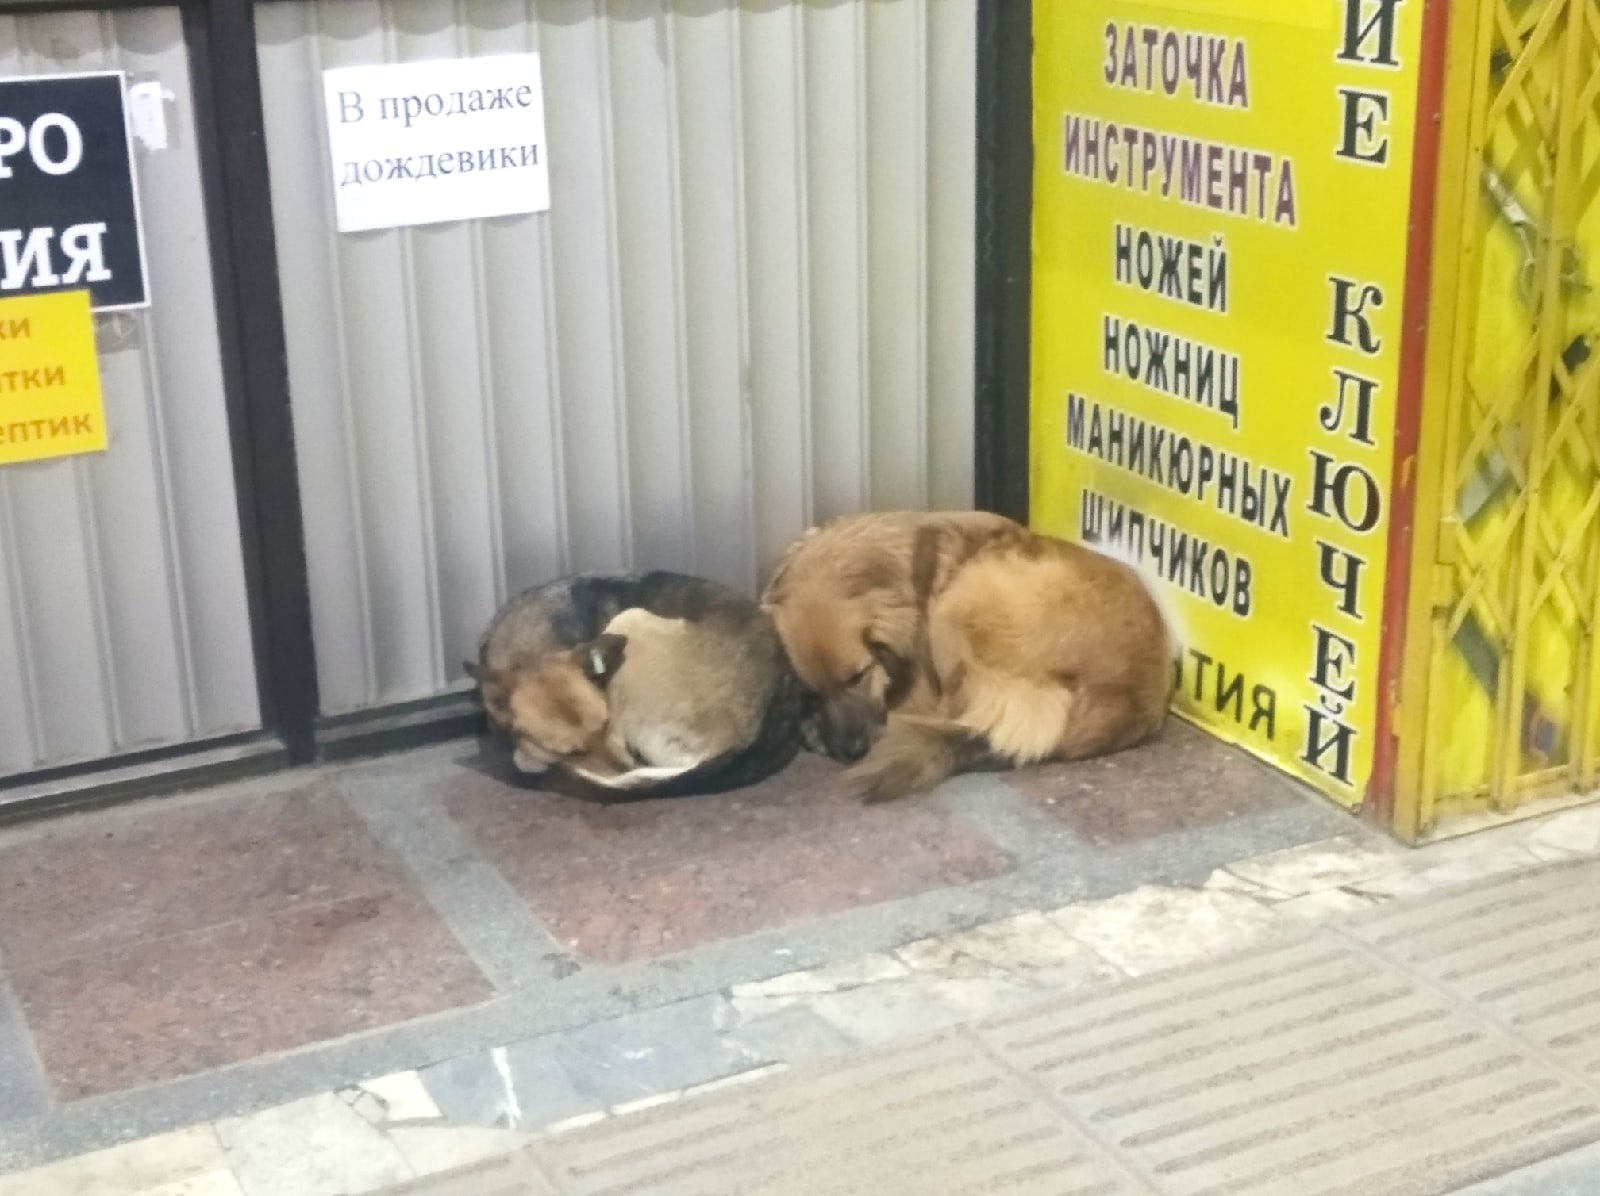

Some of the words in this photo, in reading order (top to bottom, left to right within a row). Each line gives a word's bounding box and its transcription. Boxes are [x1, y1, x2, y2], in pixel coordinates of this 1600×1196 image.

[338, 90, 364, 124] В
[379, 82, 533, 128] продаже
[1105, 22, 1248, 108] ЗАТОЧКА
[340, 142, 540, 187] дождевики
[1064, 114, 1296, 227] ИНСТРУМЕНТА
[1115, 223, 1227, 313] НОЖЕЙ
[1104, 315, 1239, 429] НОЖНИЦ
[1066, 393, 1291, 537] МАНИКЮРНЫХ
[1301, 276, 1384, 785] КЛЮЧЕЙ
